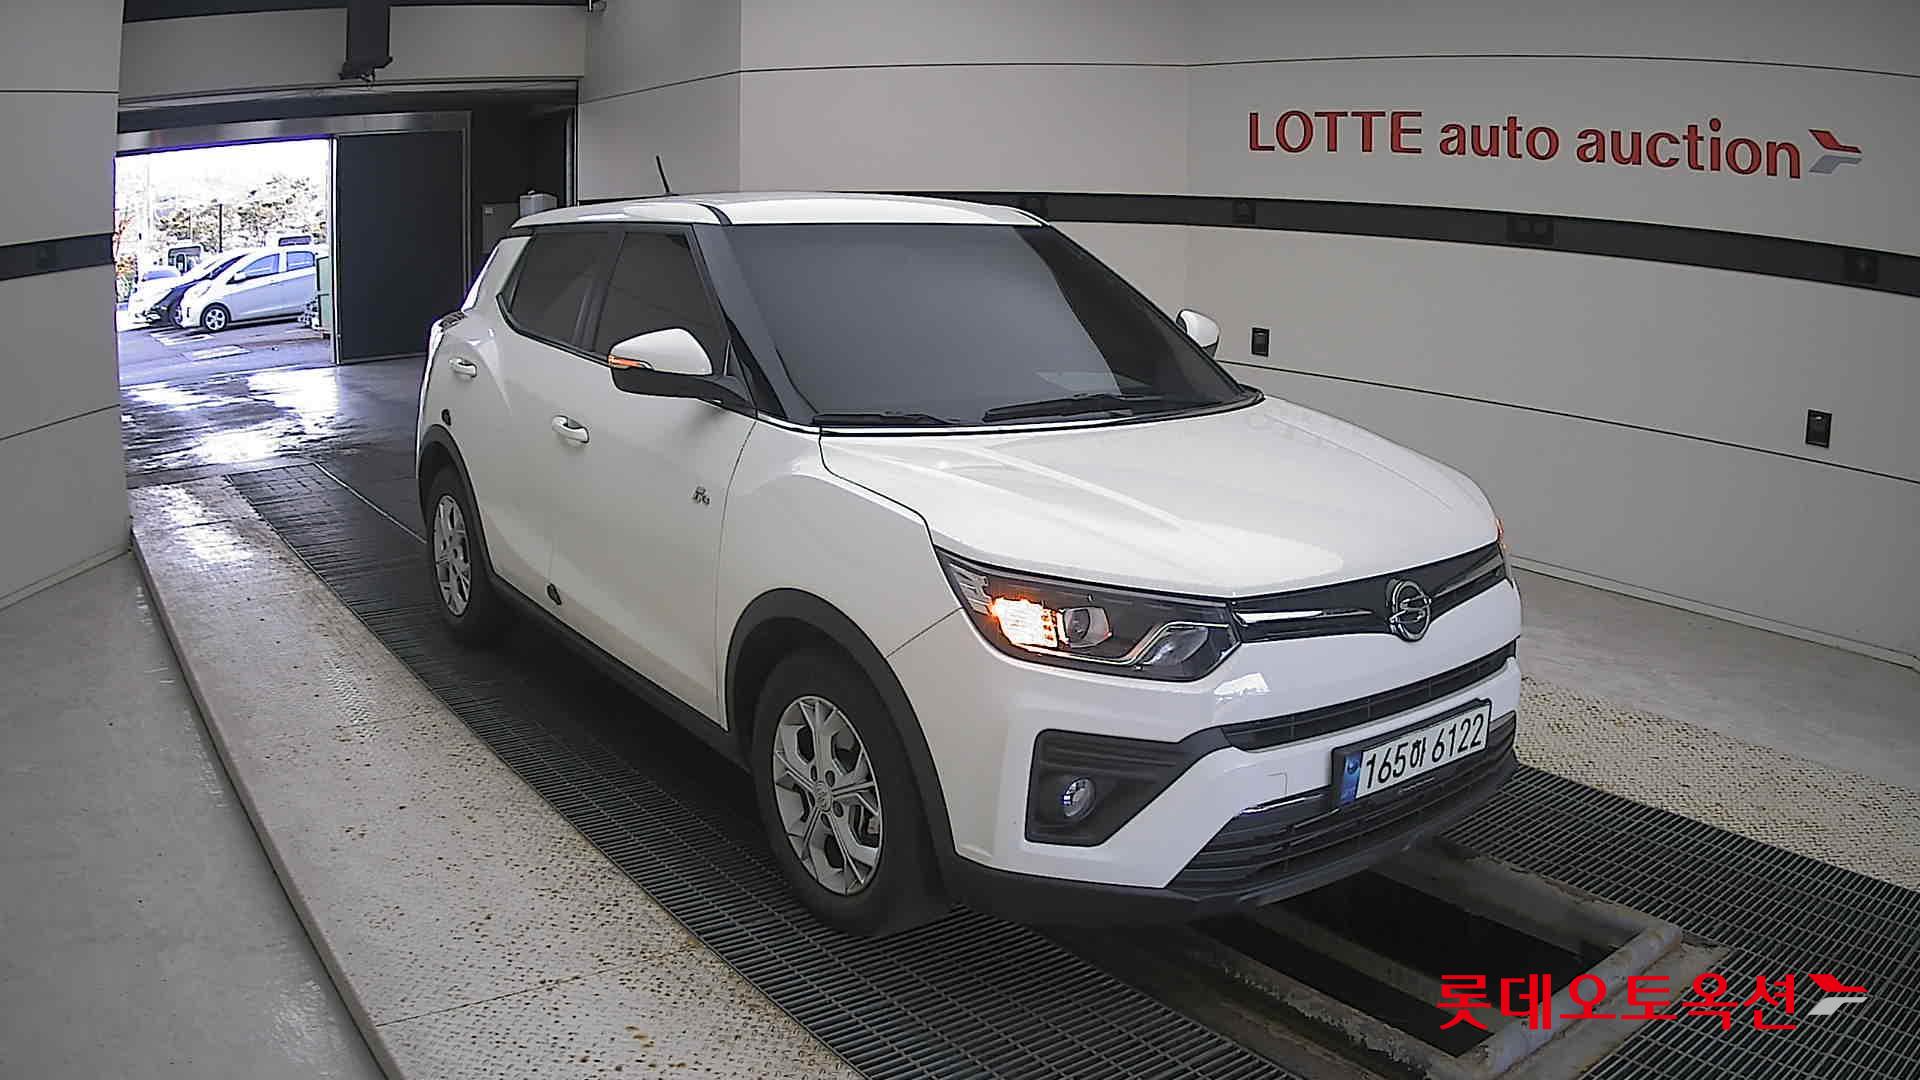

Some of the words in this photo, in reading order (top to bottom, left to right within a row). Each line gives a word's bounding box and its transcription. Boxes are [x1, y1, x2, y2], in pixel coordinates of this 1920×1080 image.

[1248, 110, 1423, 155] LOTTE
[1440, 116, 1560, 161] auto
[1576, 118, 1802, 180] auction
[1366, 737, 1427, 789] 165하
[1431, 713, 1485, 763] 6122
